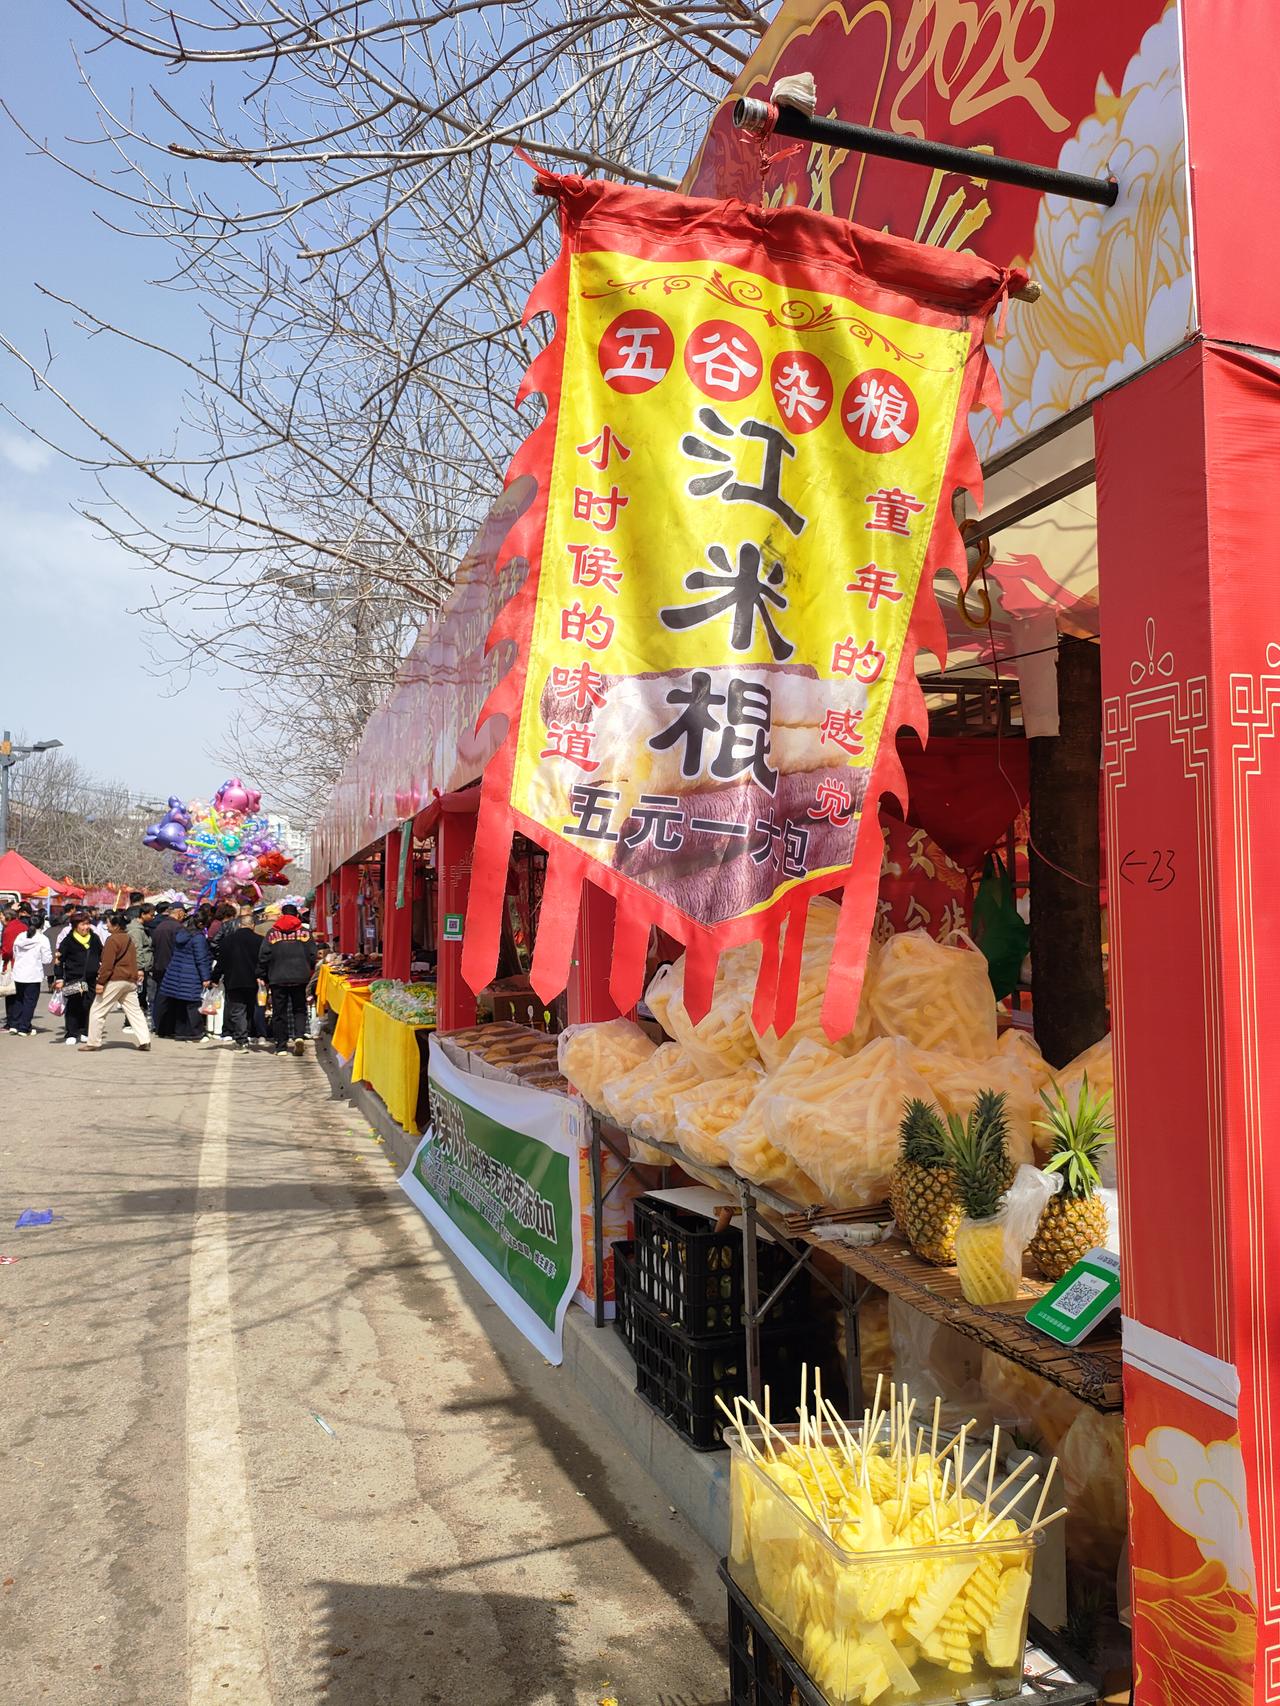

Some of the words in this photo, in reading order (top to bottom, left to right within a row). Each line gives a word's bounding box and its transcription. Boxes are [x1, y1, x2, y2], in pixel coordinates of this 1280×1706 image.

[604, 327, 910, 443] 五谷杂粮
[540, 425, 631, 773] 小时候的味道
[650, 406, 807, 797] 江米棍
[806, 487, 926, 828] 童年的感觉
[562, 783, 809, 880] 五元一大包
[1147, 850, 1176, 891] 23
